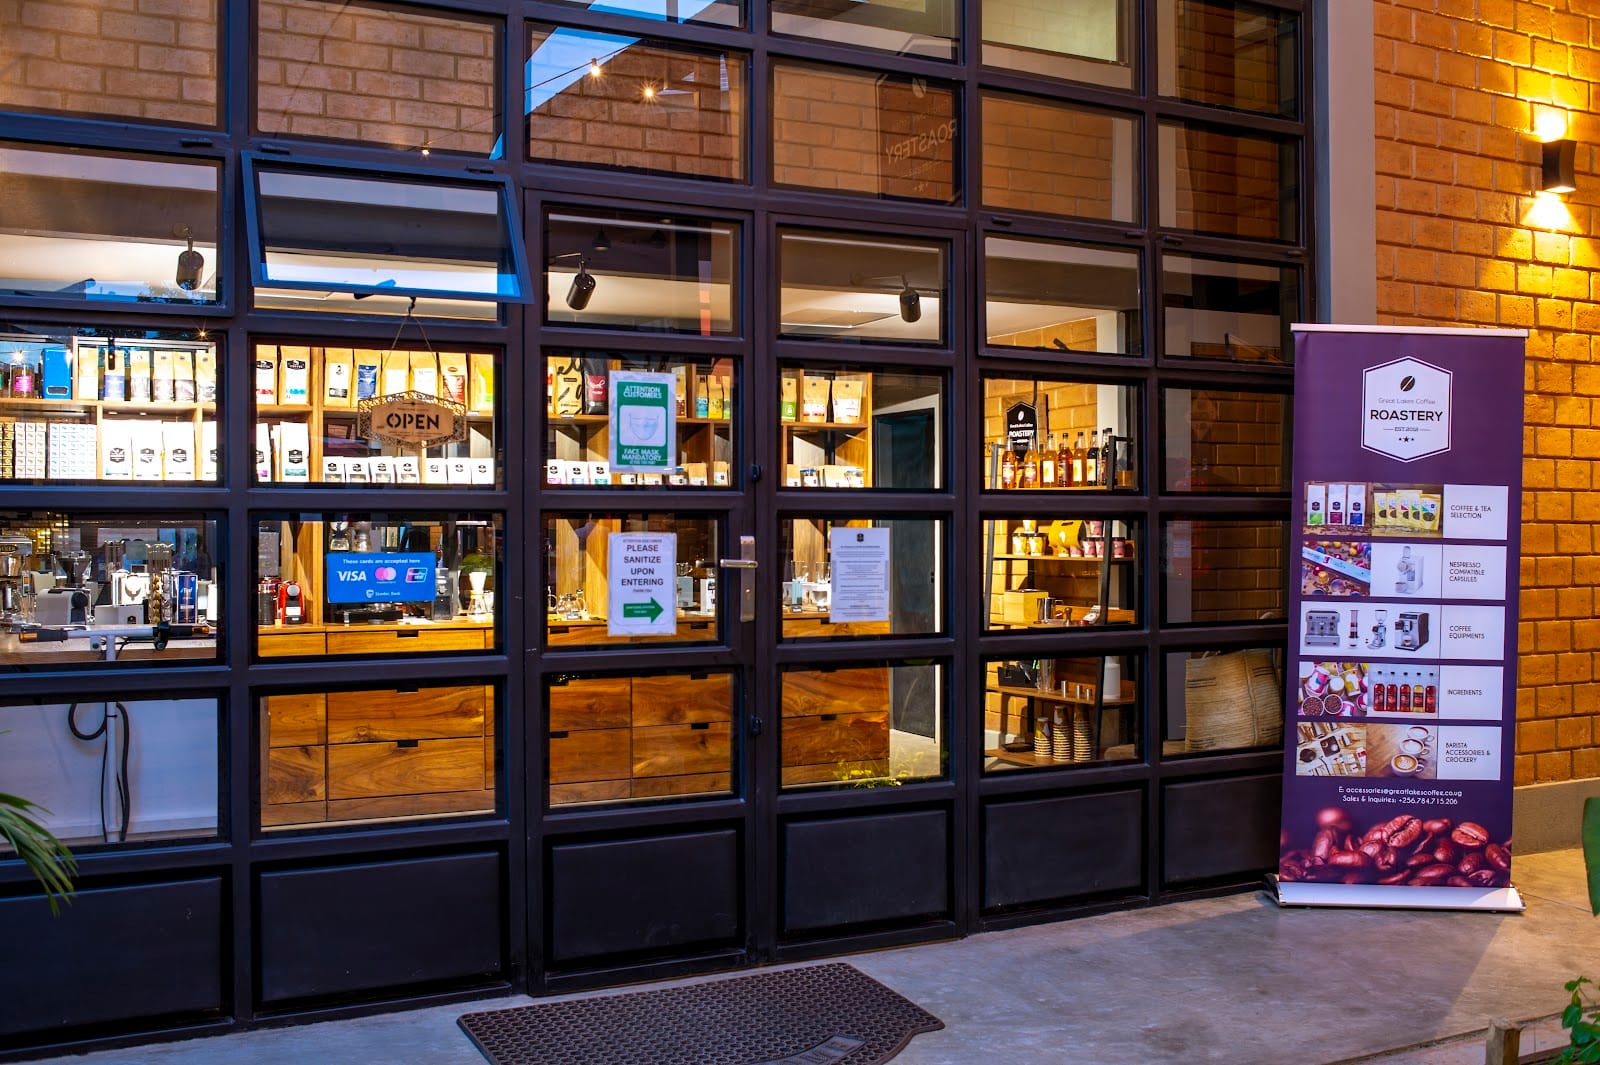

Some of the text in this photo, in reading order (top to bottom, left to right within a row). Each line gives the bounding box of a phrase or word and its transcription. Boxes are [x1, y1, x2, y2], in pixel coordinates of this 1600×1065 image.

[386, 412, 439, 429] OPEN
[1370, 409, 1443, 421] ROASTERY
[626, 544, 659, 552] PLEASE
[336, 570, 367, 582] VISA
[621, 578, 664, 586] ENTERING
